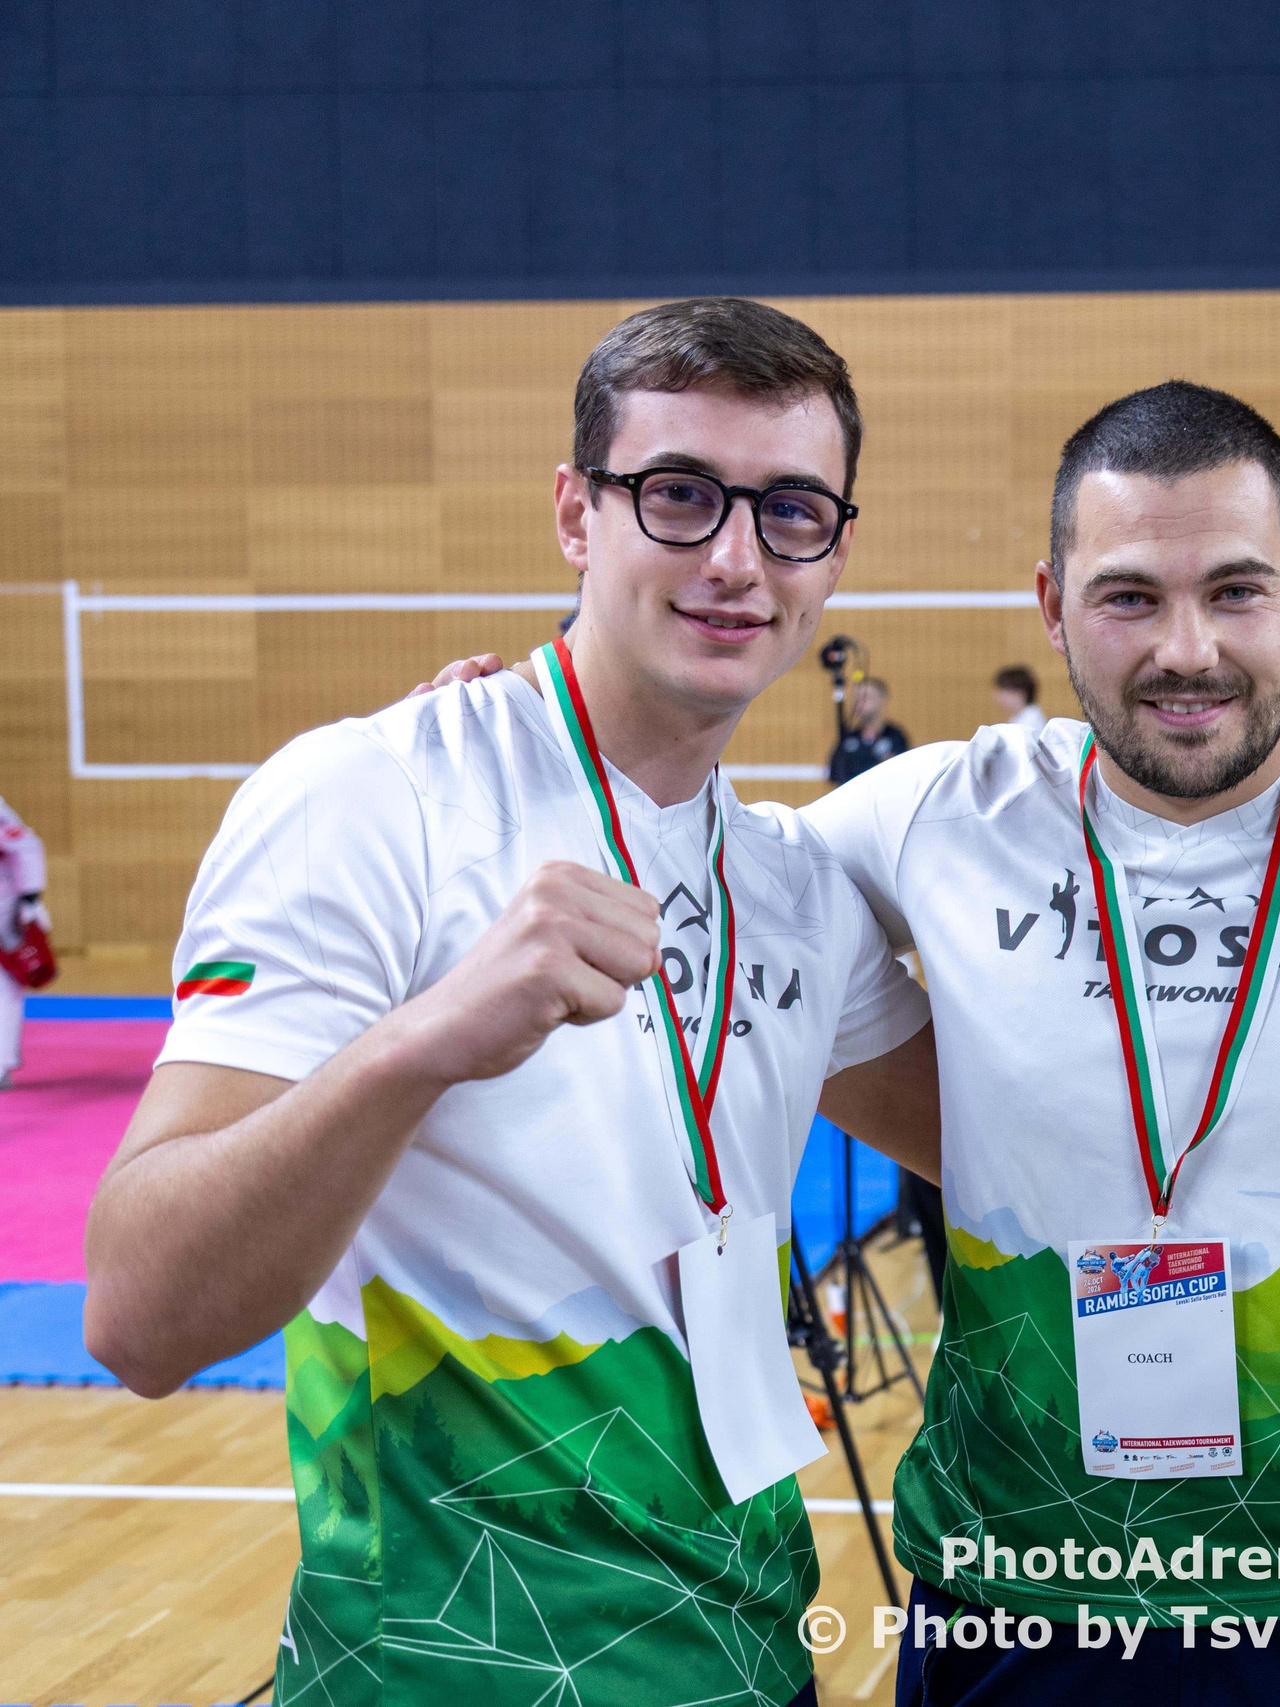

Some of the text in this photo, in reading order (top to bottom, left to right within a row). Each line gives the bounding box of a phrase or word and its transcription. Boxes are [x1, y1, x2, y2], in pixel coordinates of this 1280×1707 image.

[1167, 1248, 1210, 1261] INTERNATIONAL
[1168, 1256, 1203, 1268] TAEKWONDO
[1168, 1262, 1206, 1275] TOURNAMENT
[1085, 1275, 1219, 1314] RAMUS SOFIA CUP
[1203, 1293, 1217, 1301] Sports
[1127, 1353, 1173, 1364] COACH
[1122, 1439, 1162, 1447] INTERNATIONAL
[1162, 1438, 1196, 1446] TAEKWONDO
[1196, 1437, 1231, 1445] TOURNAMENT
